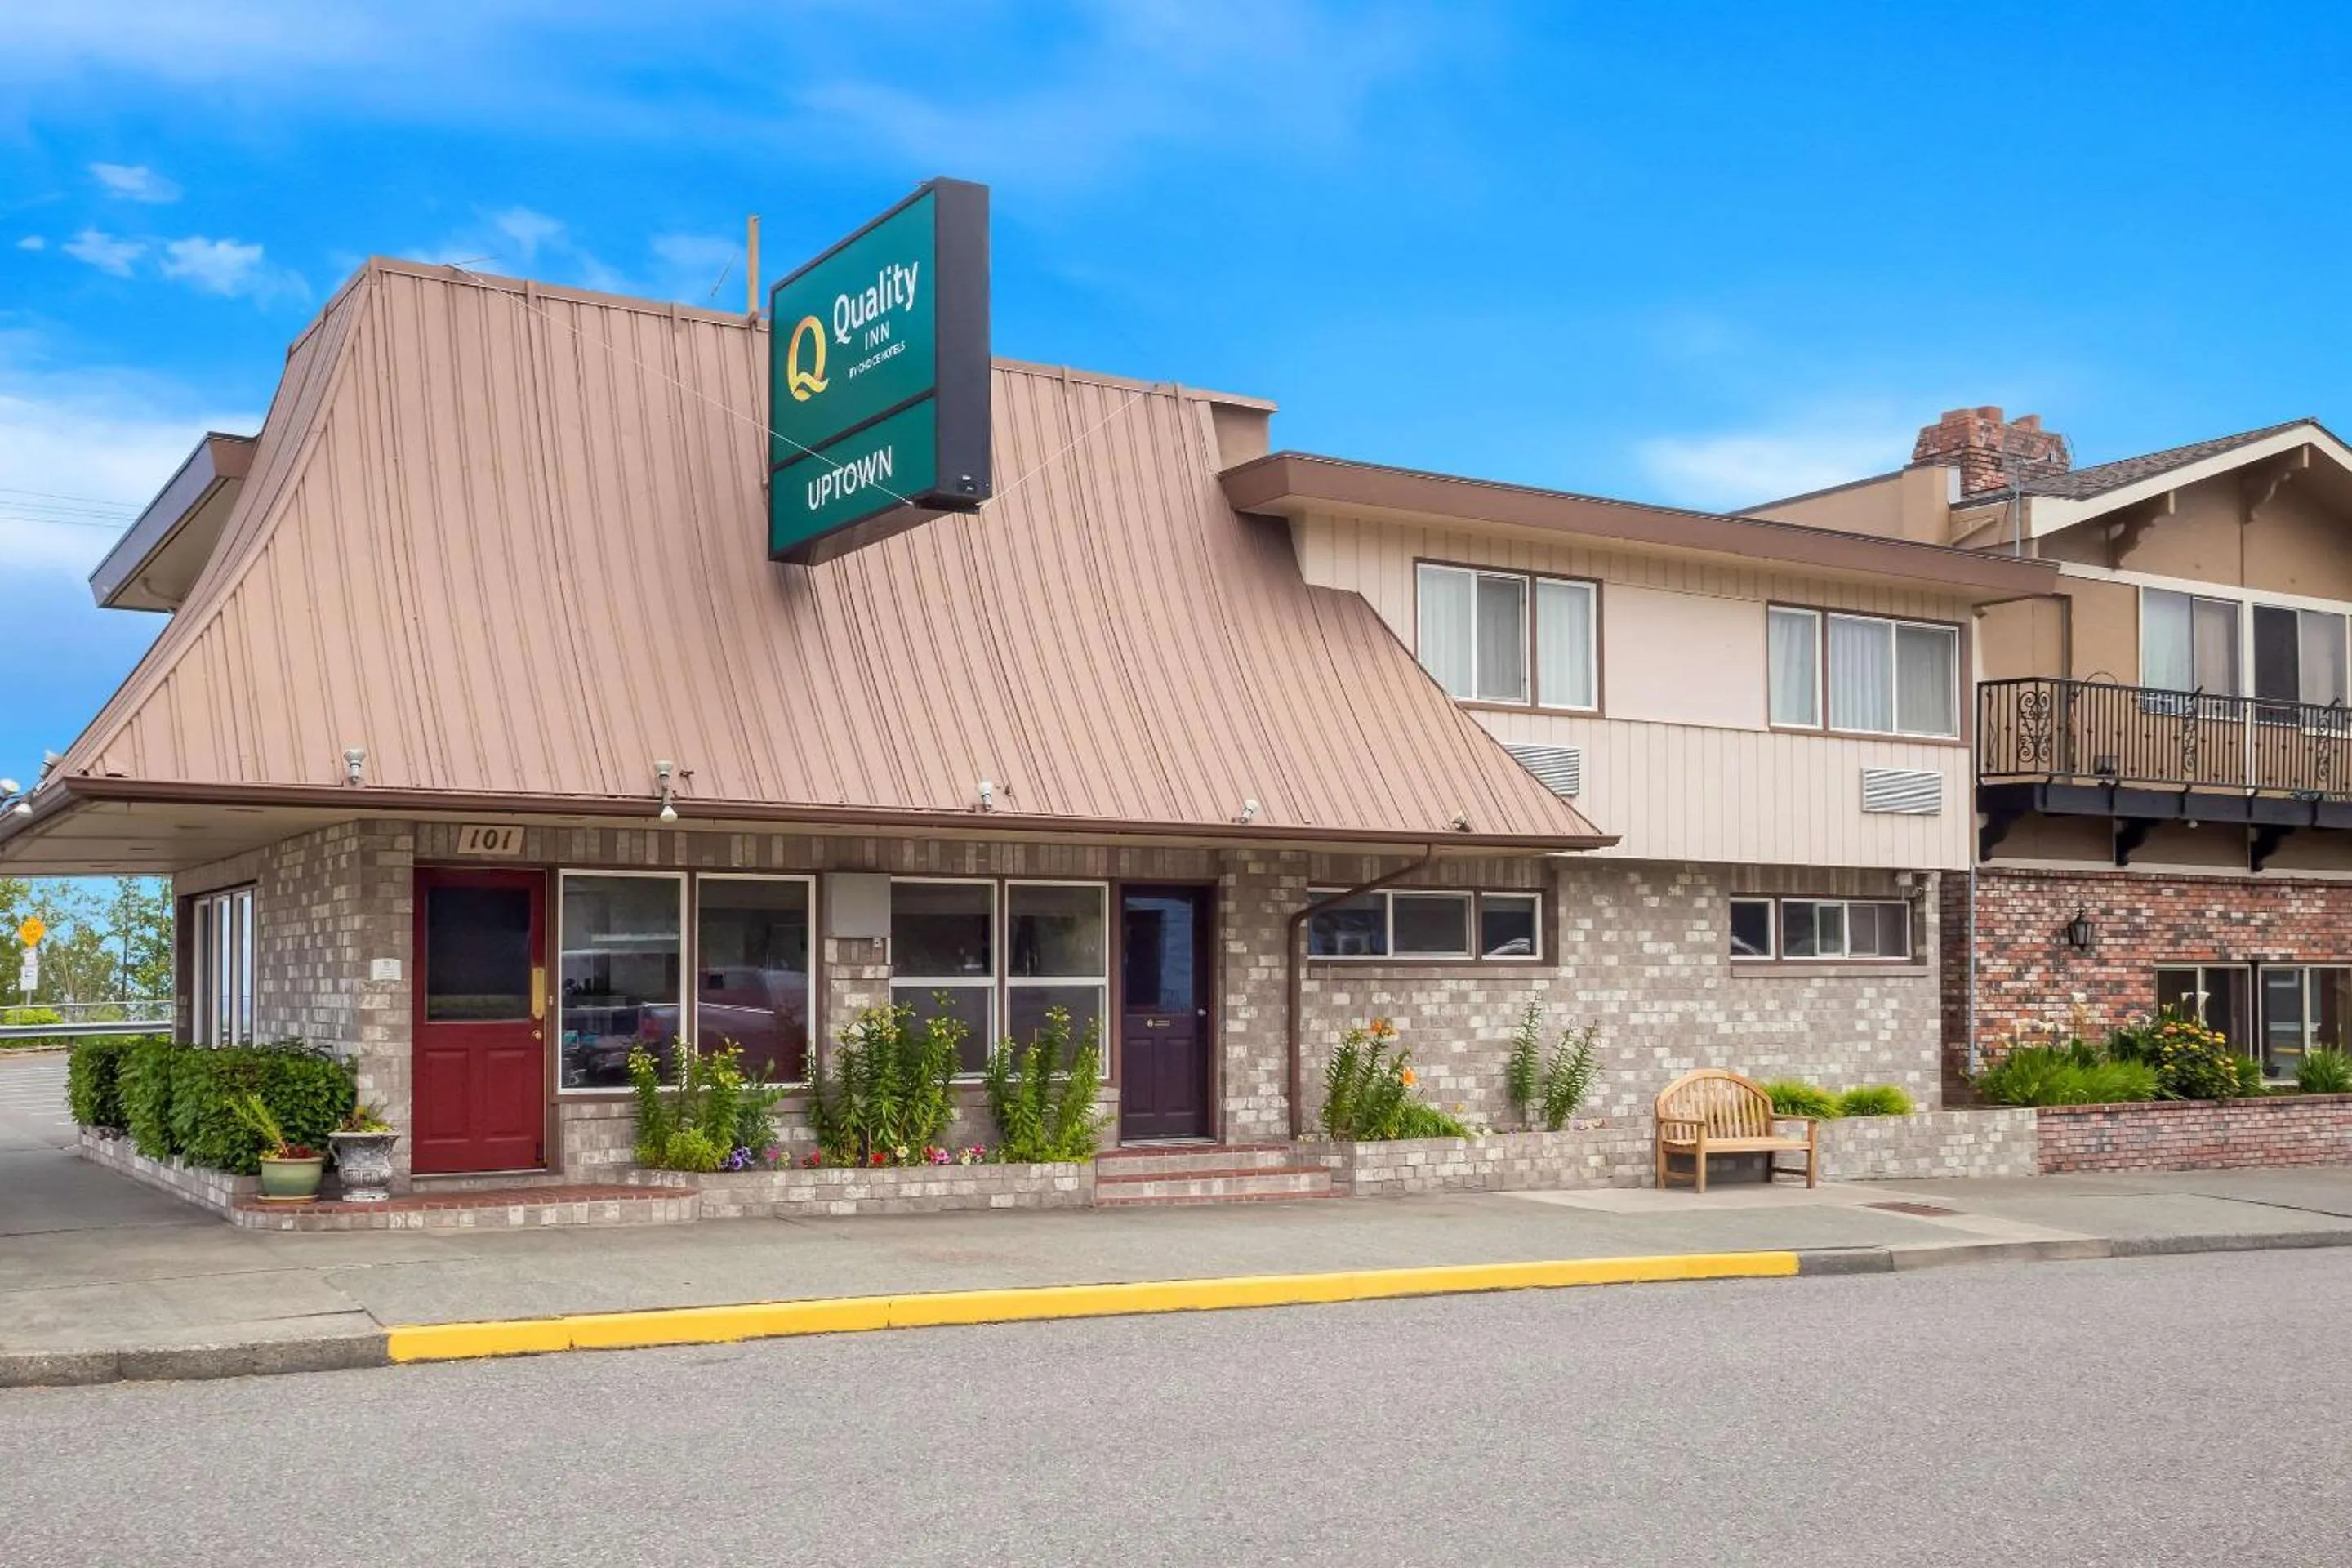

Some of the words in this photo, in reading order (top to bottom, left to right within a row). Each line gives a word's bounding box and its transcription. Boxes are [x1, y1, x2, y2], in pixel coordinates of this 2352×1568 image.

[833, 261, 919, 345] Quality
[787, 315, 830, 402] Q
[858, 353, 880, 373] CHOICE
[881, 340, 906, 361] HOTELS
[865, 320, 890, 351] INN
[808, 445, 893, 510] UPTOWN
[470, 828, 512, 850] 101
